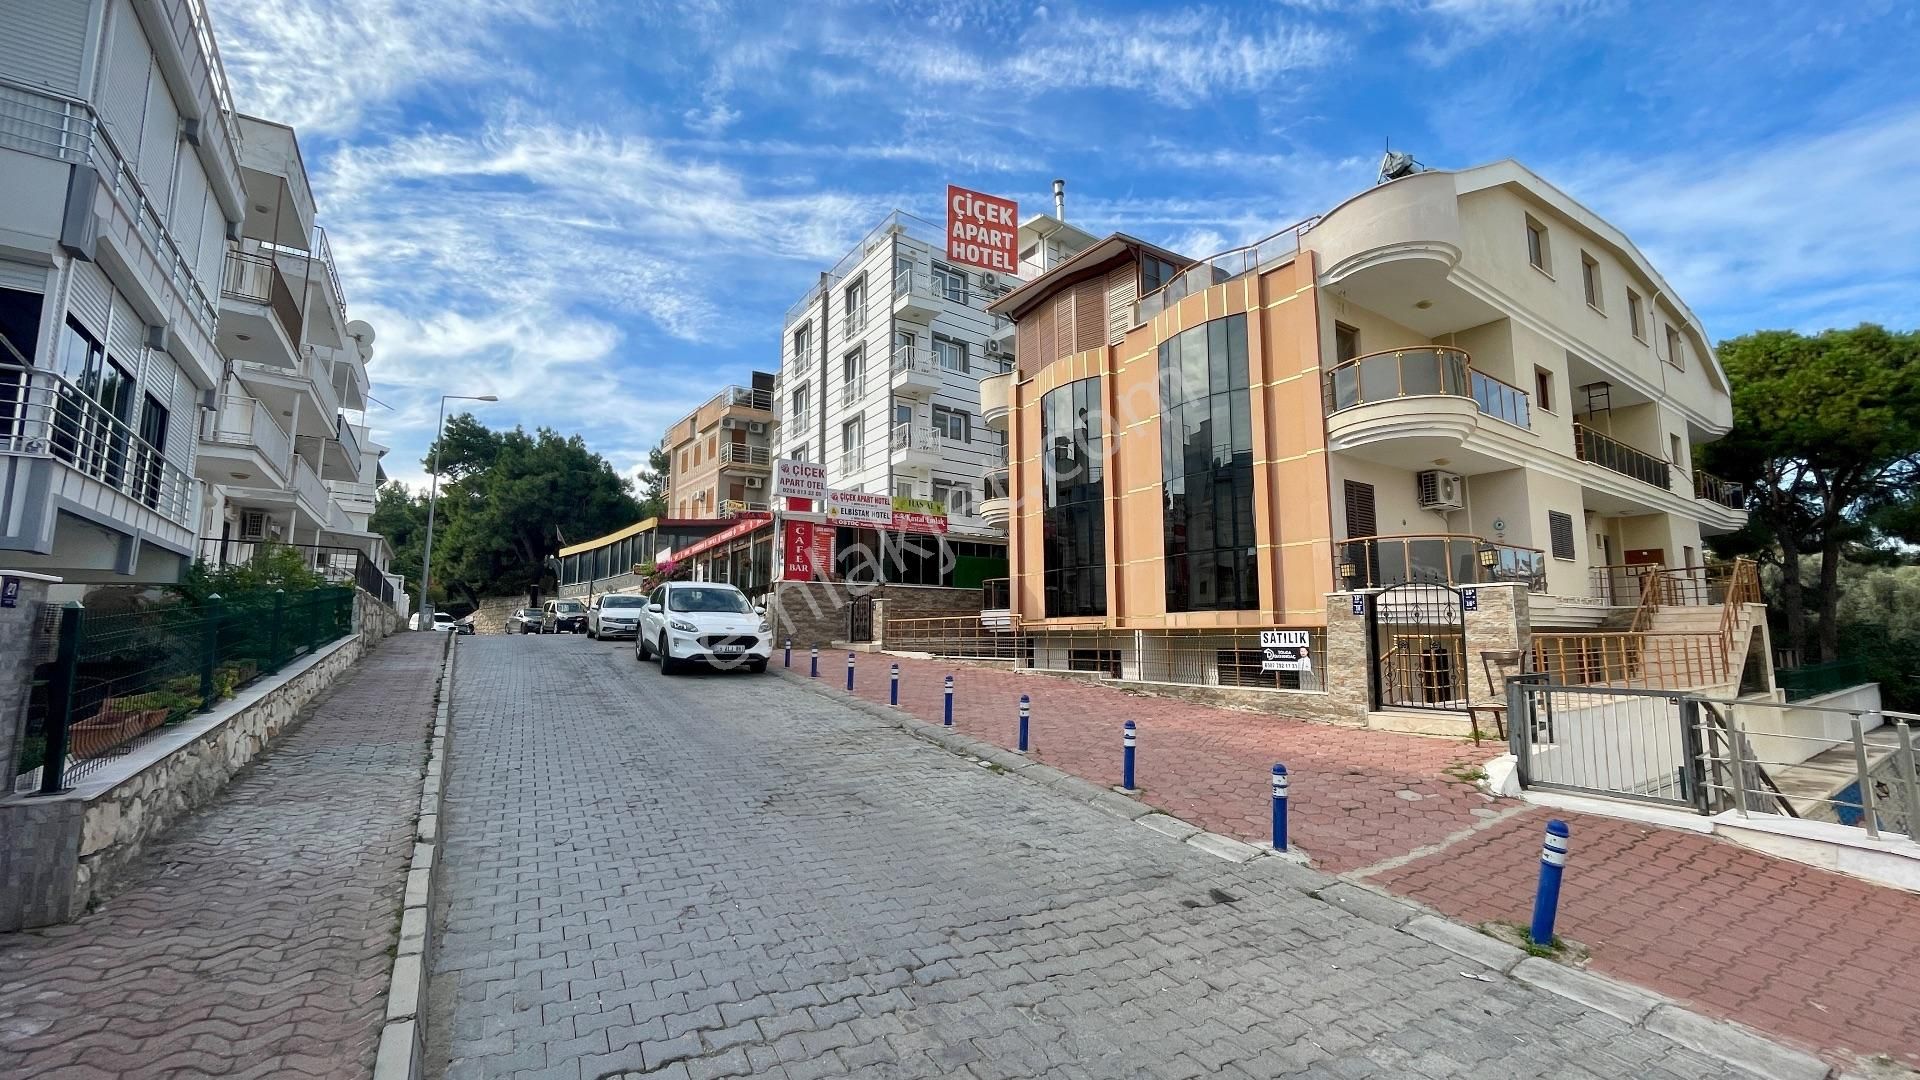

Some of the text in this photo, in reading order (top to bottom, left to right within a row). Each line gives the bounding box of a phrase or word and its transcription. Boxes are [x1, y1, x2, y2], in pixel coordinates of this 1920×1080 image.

[952, 193, 1014, 227] ÇİÇEK
[952, 220, 1014, 250] APART
[952, 241, 1014, 270] HOTEL
[792, 463, 825, 479] ÇİÇEK
[779, 477, 825, 490] APART OTEL
[839, 492, 857, 504] ÇİÇEK
[857, 493, 874, 504] APART
[874, 495, 891, 506] HOTEL
[871, 511, 890, 520] HOTEL
[789, 563, 809, 573] BAR
[1263, 632, 1306, 644] SATILIK
